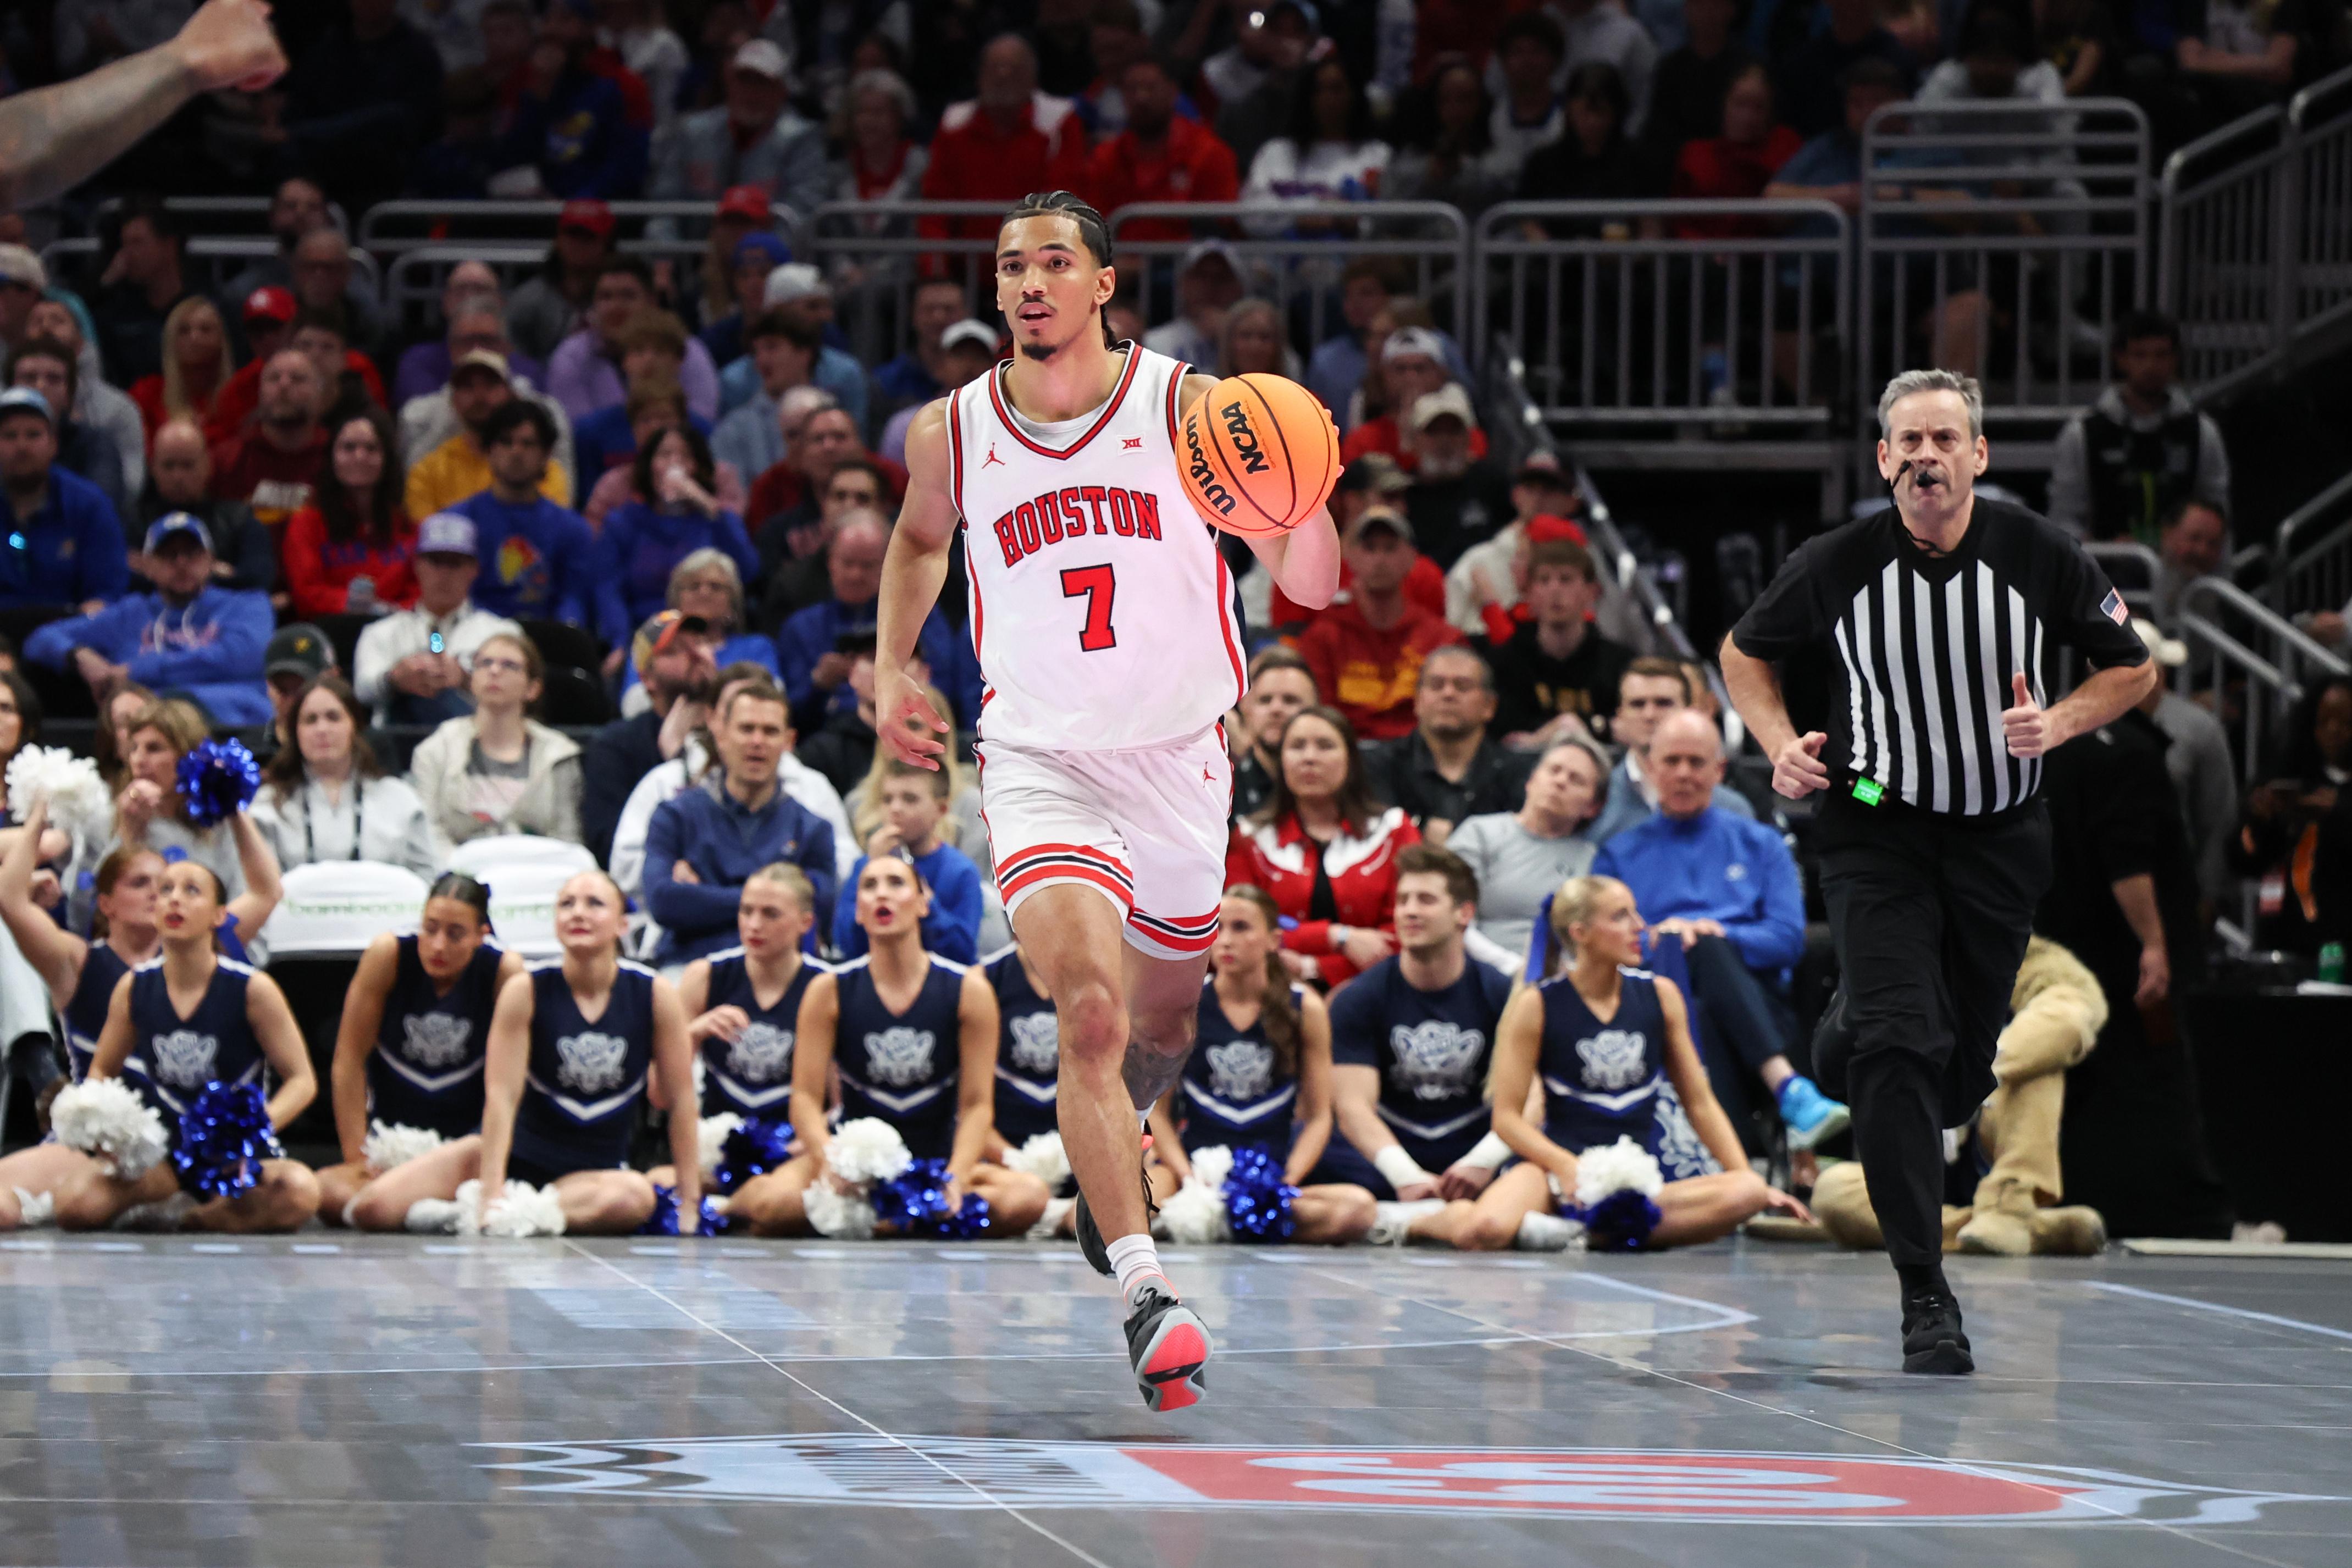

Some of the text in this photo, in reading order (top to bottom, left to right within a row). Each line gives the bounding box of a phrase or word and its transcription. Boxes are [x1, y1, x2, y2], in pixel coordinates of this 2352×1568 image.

[1186, 410, 1237, 517] Wilson
[1220, 401, 1270, 474] NCAA
[994, 486, 1162, 568] HOUSTON
[1060, 563, 1116, 652] 7
